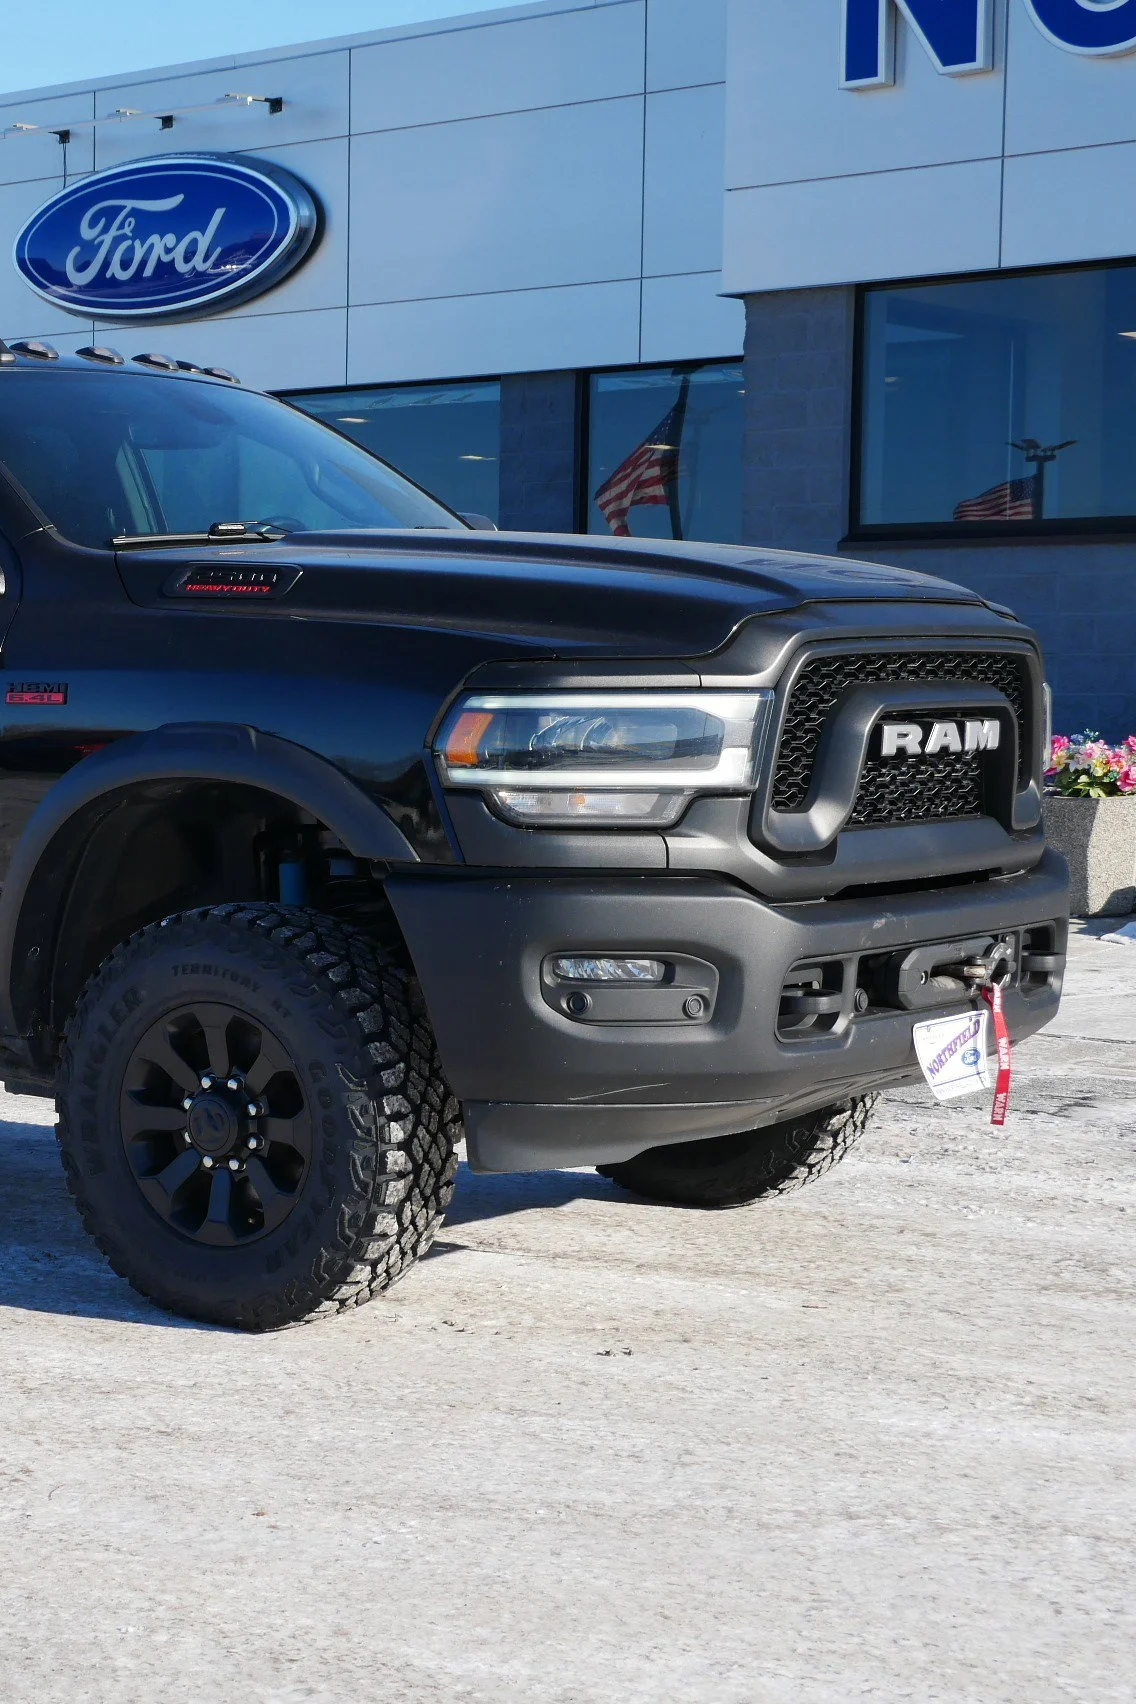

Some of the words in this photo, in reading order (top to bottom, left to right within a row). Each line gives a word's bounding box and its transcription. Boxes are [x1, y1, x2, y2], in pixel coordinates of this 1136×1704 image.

[65, 193, 227, 287] Ford
[7, 682, 68, 693] HEMI
[881, 719, 1001, 757] RAM
[170, 963, 264, 994] TERRITORY
[926, 1018, 981, 1080] NORTHFIELD
[997, 1036, 1010, 1070] WARN
[993, 1092, 1007, 1121] WARN
